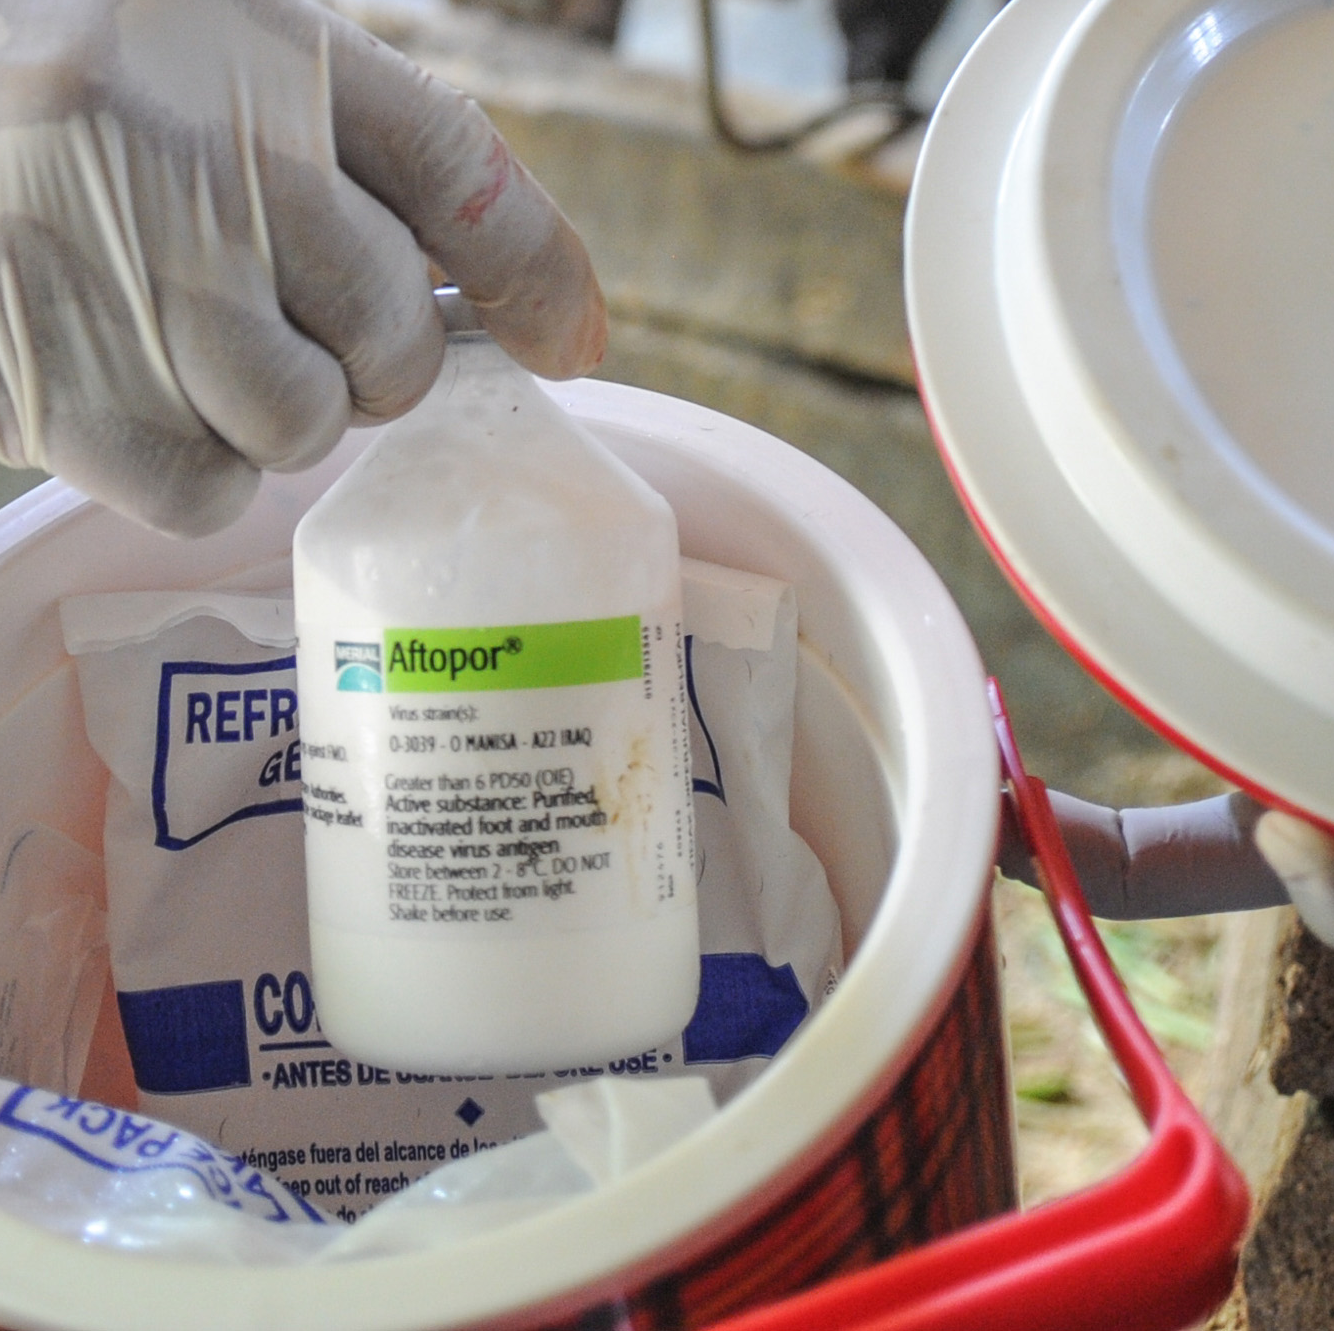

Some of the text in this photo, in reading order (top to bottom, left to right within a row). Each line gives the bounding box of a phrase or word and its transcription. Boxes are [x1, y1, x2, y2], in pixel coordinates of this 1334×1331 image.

[389, 705, 418, 721] Virus
[466, 732, 518, 752] MANISA
[531, 731, 557, 749] A22
[561, 727, 592, 748] IRAQ
[385, 767, 574, 790] Greater than 6 PD50 (OIE)
[385, 794, 431, 812] Active
[436, 794, 525, 812] substance:
[386, 809, 607, 836] inactivated foot and mouth
[387, 837, 560, 863] disease virus antigen
[388, 862, 421, 880] Store
[426, 863, 488, 880] between
[492, 864, 501, 879] 2
[552, 857, 576, 875] DO
[580, 852, 611, 872] NOT
[447, 884, 498, 901] Protect
[502, 882, 538, 899] from
[389, 904, 427, 922] Shake
[432, 904, 480, 922] before
[253, 970, 321, 1037] CO
[273, 1059, 353, 1090] ANTES
[236, 1148, 306, 1172] téngase
[310, 1142, 352, 1166] fuera
[356, 1140, 379, 1163] del
[384, 1140, 446, 1163] alcance
[450, 1138, 470, 1160] de
[315, 1174, 341, 1195] out
[345, 1172, 361, 1194] of
[366, 1171, 410, 1194] reach
